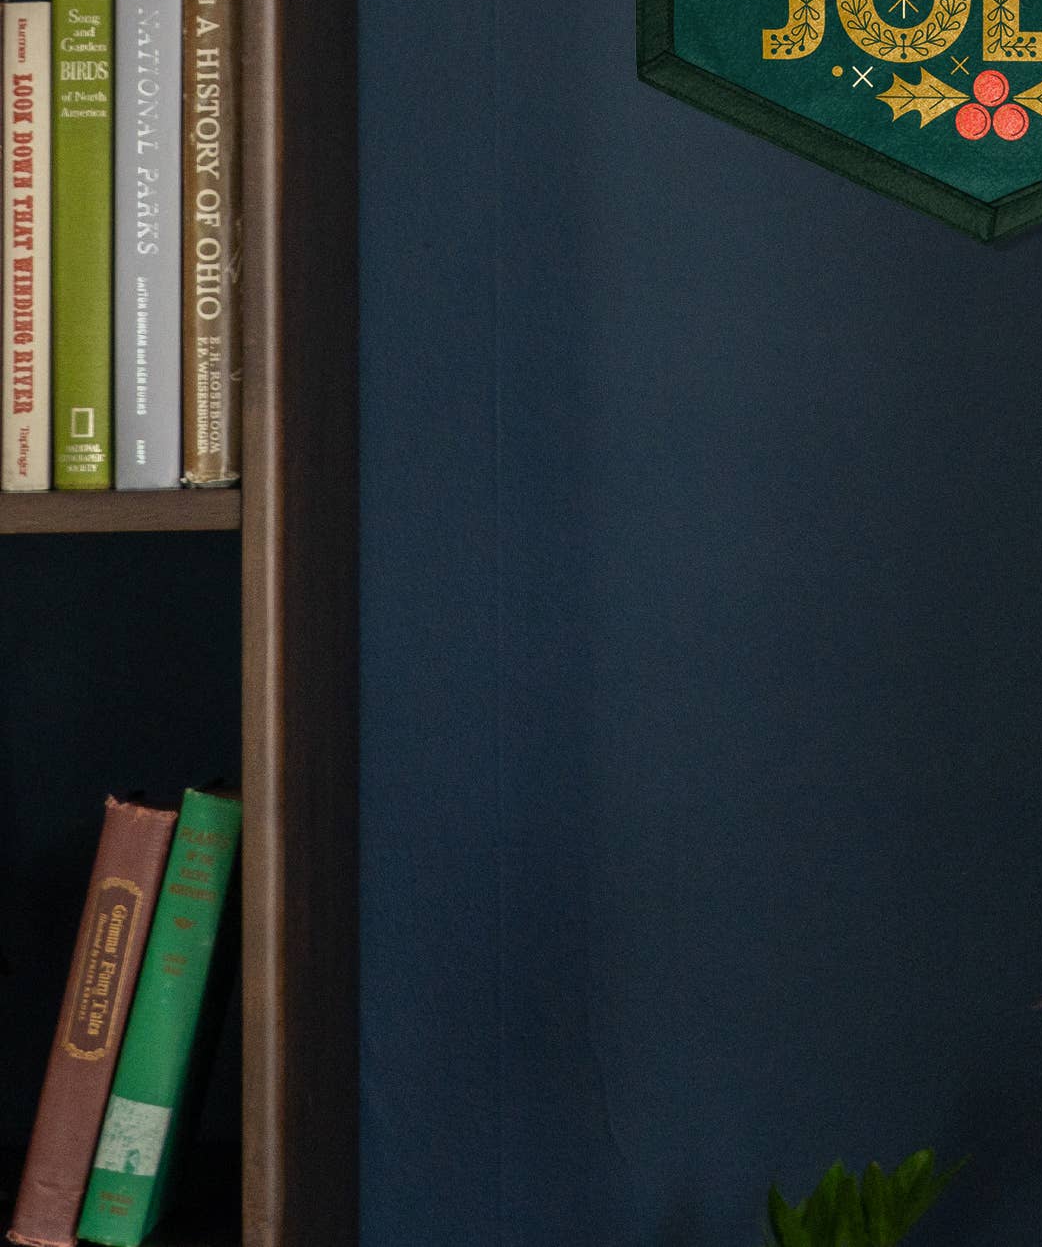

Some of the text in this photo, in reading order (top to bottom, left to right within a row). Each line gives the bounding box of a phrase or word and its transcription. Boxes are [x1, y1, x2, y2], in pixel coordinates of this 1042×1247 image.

[61, 37, 107, 52] Garden
[68, 8, 100, 26] Song
[73, 27, 96, 37] and
[60, 60, 109, 81] BIRDS
[137, 7, 160, 154] NATIONAL
[196, 16, 222, 320] A HISTORY OF OHIO
[12, 73, 34, 415] LOOK DOWN THAT WINDING RIVER
[137, 167, 159, 255] PARKS
[197, 362, 209, 455] WEISENBURGER
[209, 372, 222, 453] ROSEBOOM
[87, 999, 110, 1035] Tales
